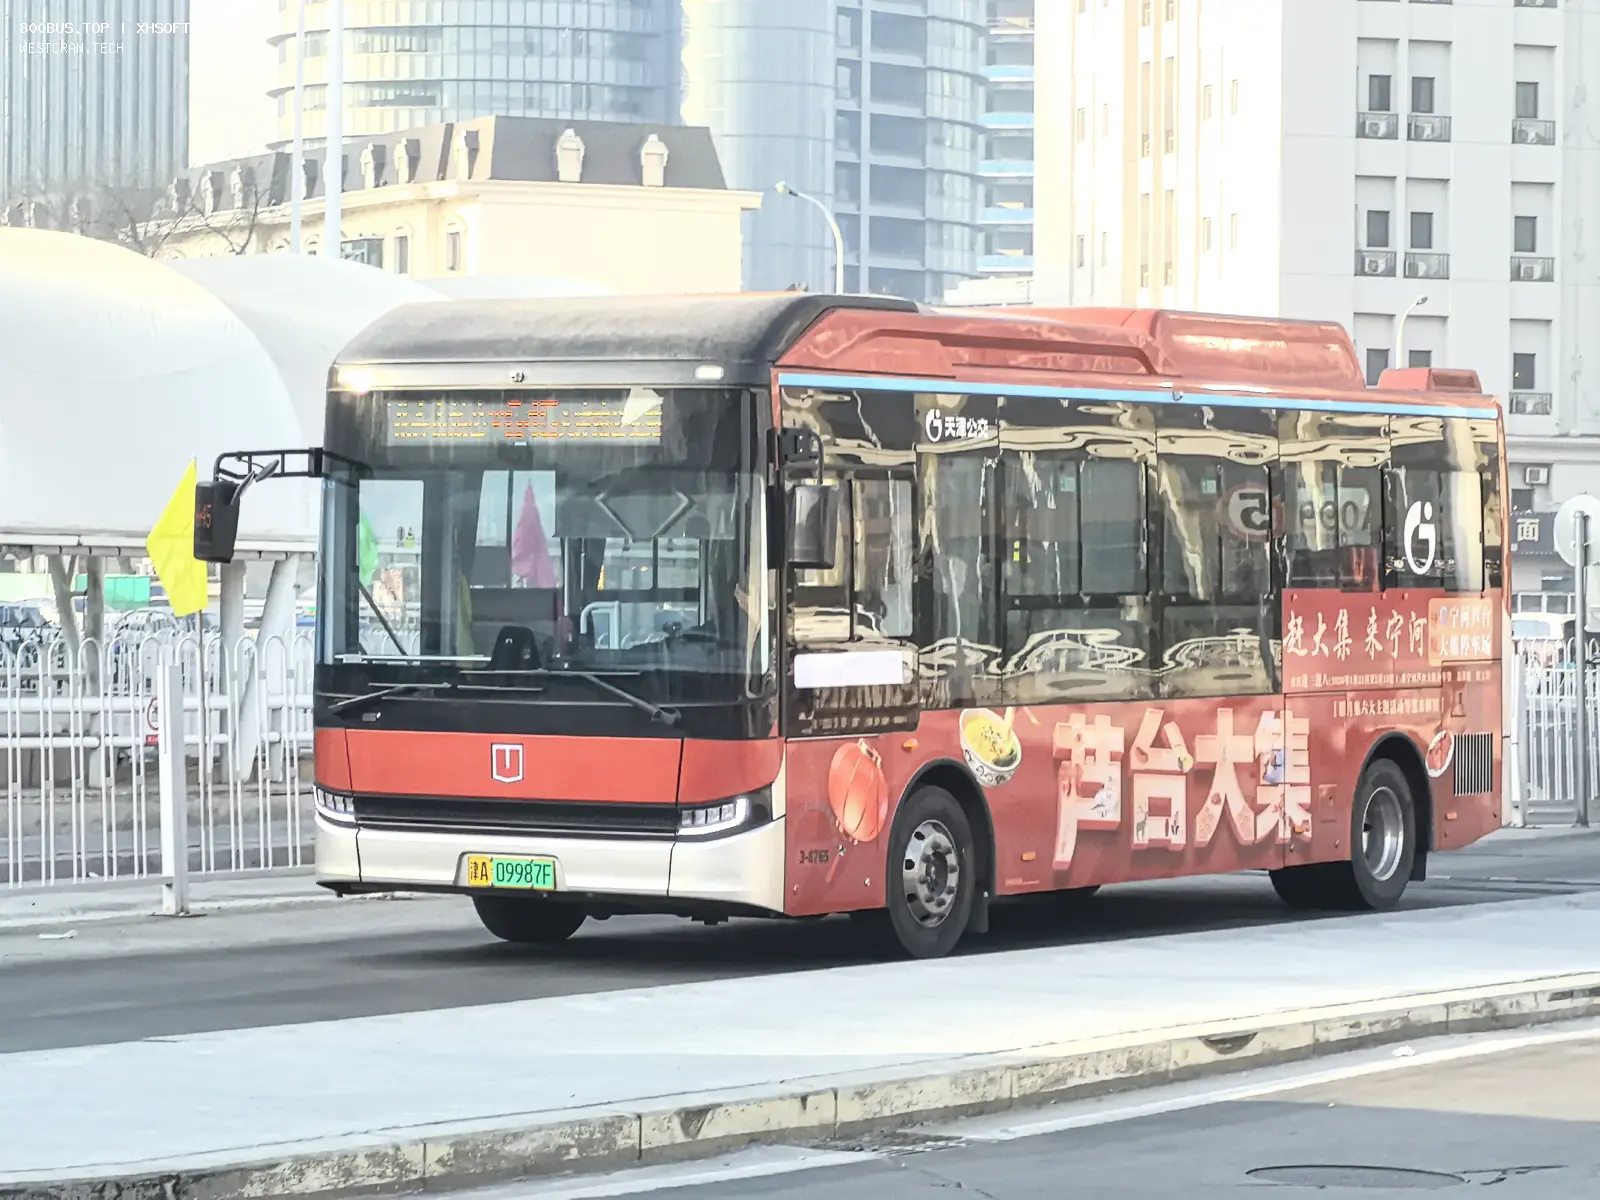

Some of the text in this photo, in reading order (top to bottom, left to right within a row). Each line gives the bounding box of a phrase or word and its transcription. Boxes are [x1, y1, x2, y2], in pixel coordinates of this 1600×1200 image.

[944, 416, 989, 439] 天津公交
[1516, 518, 1540, 542] 面
[1282, 606, 1428, 661] 赶大集 来宁河
[1052, 707, 1313, 871] 芦台大集
